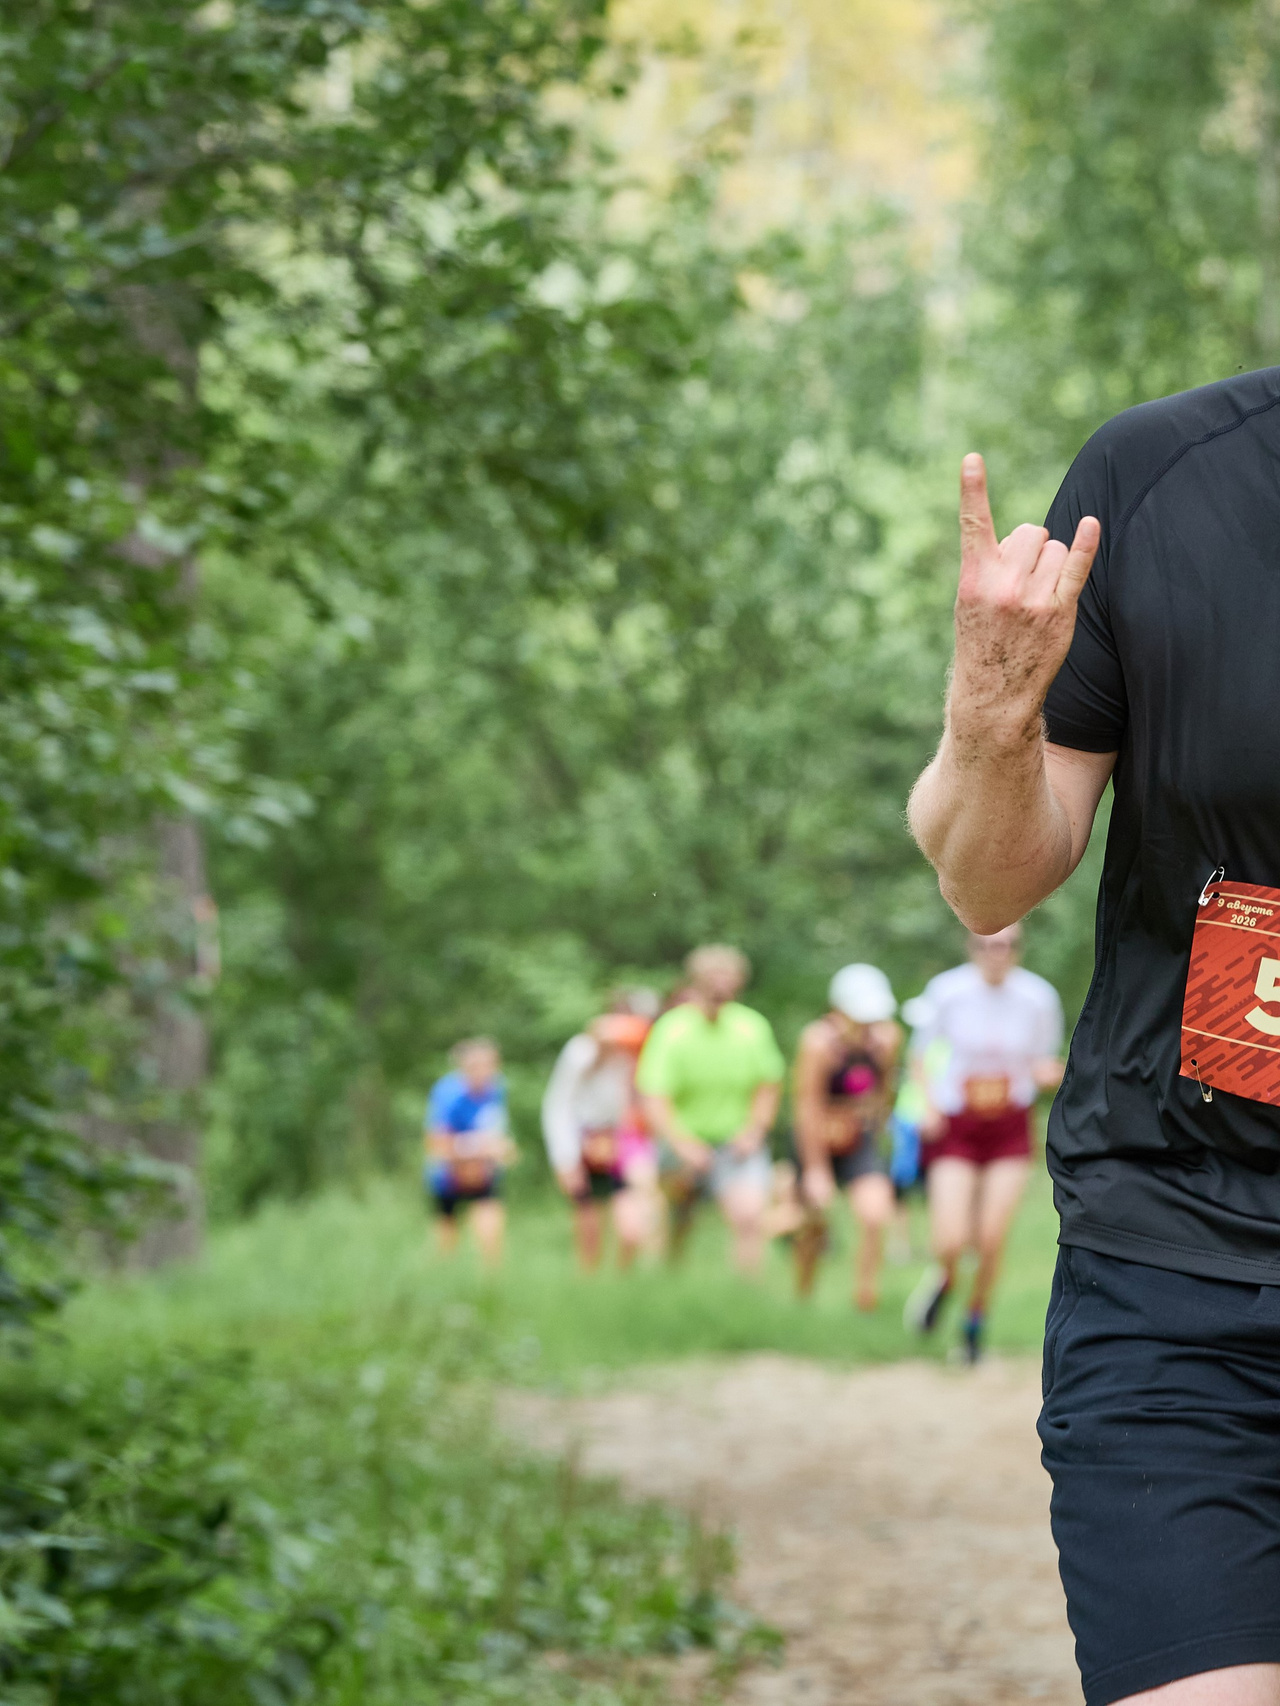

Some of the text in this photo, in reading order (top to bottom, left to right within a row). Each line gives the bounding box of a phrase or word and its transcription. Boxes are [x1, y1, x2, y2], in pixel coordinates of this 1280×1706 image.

[1217, 898, 1274, 917] 9 августа
[1230, 914, 1257, 928] 2026
